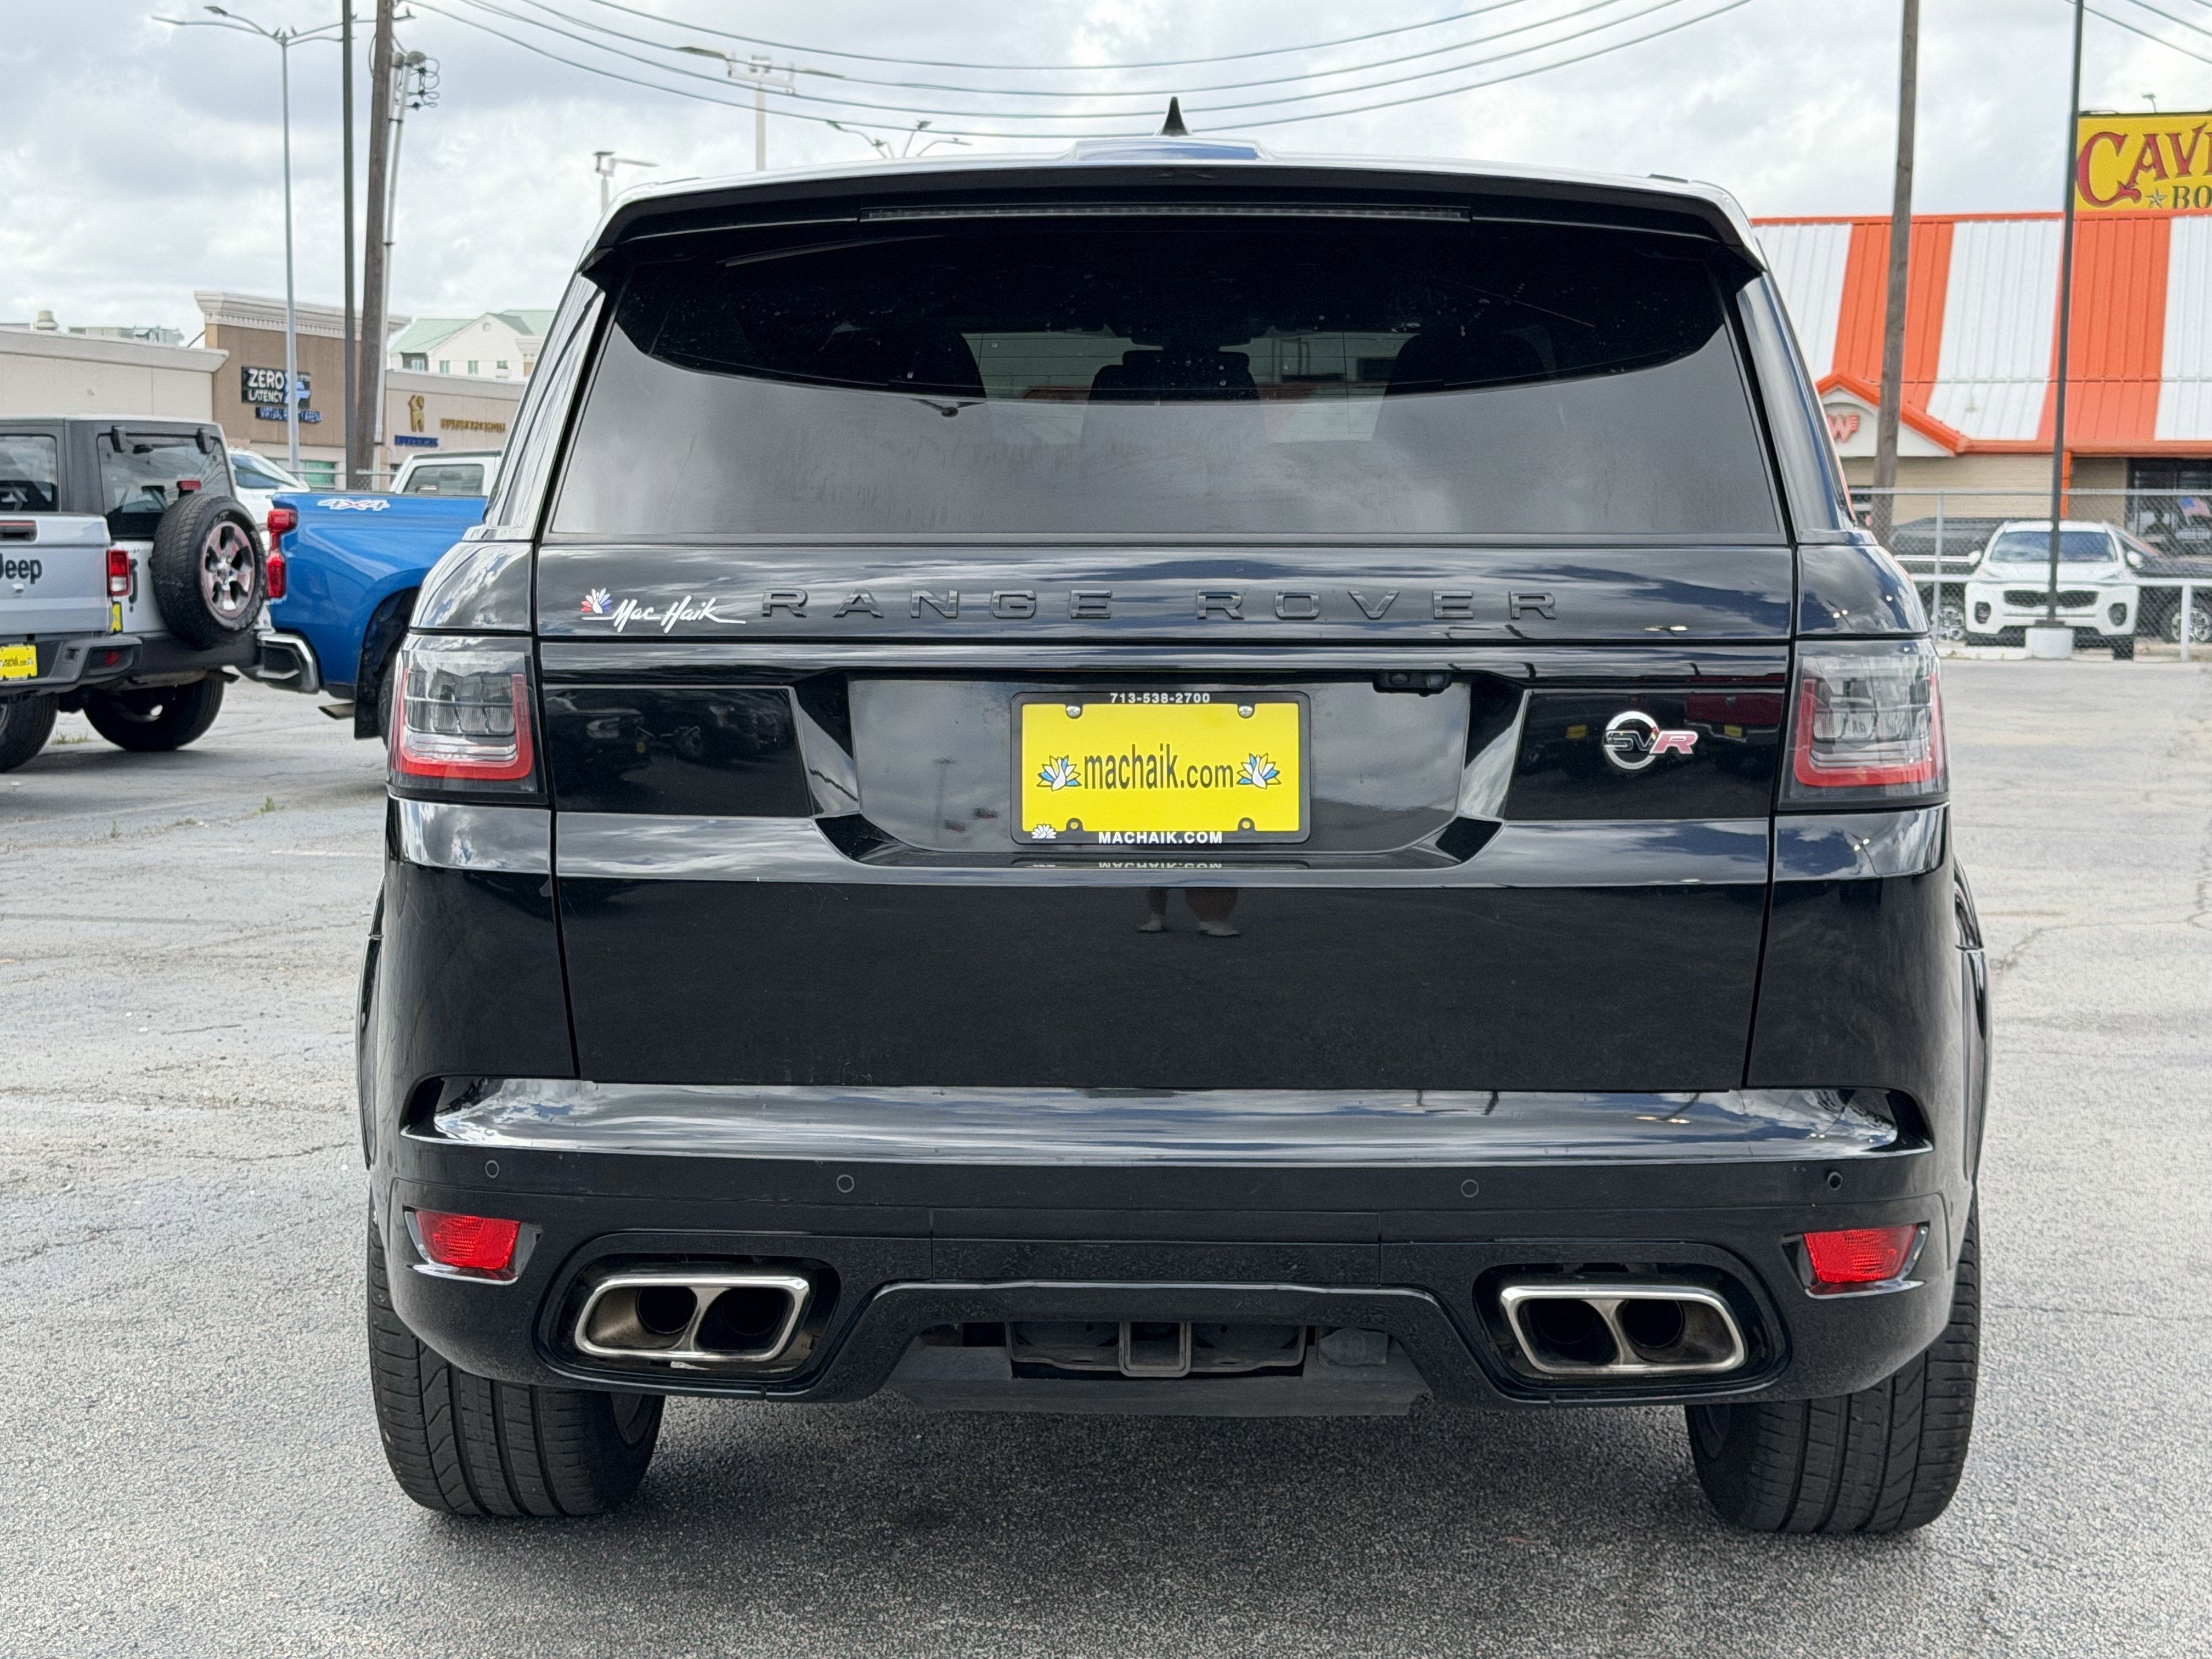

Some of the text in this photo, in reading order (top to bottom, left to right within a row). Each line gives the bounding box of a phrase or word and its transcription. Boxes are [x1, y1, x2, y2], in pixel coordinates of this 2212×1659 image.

[2076, 120, 2212, 208] CAV
[248, 368, 284, 390] ZERO
[612, 595, 723, 634] Mac Haik
[761, 588, 1558, 620] RANGE ROVER
[1110, 692, 1211, 704] 713-538-2700
[1605, 730, 1699, 755] SVR
[1084, 743, 1234, 789] machaik.com
[1098, 831, 1223, 844] MACHAIK.COM
